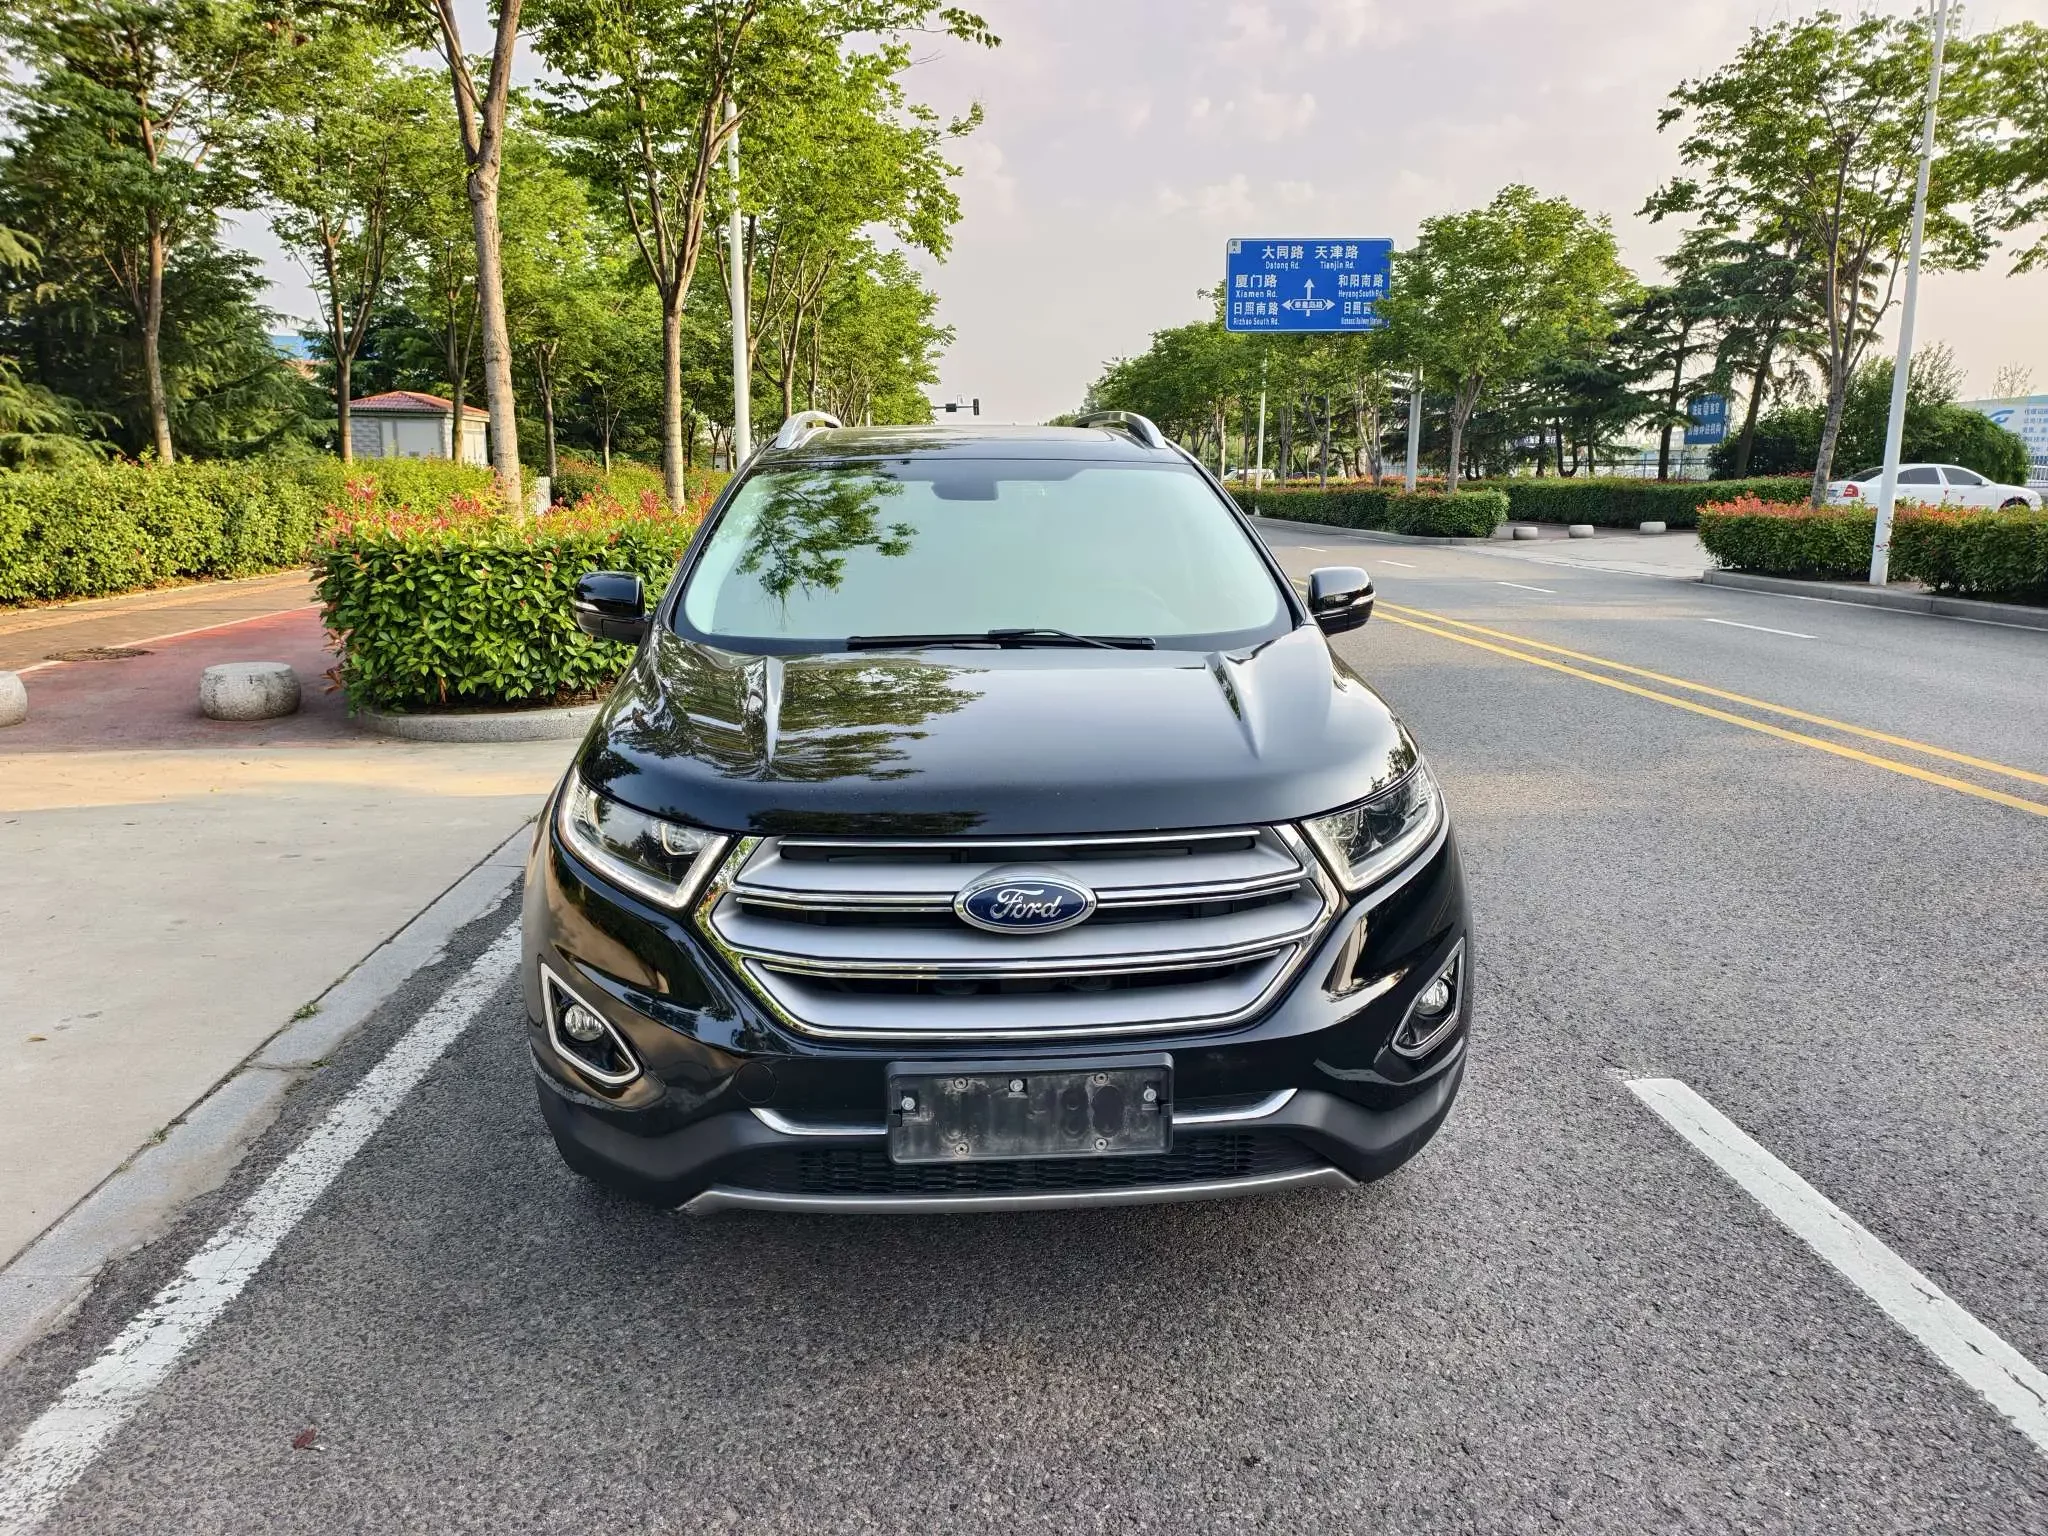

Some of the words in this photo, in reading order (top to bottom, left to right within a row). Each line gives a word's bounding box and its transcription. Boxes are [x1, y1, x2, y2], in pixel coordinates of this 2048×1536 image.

[1262, 245, 1304, 260] 大同路
[1314, 245, 1359, 260] 天津路
[1265, 261, 1289, 271] Datong
[1320, 261, 1343, 271] Tianjin
[1235, 274, 1277, 288] 厦门路
[1338, 274, 1384, 288] 和阳南路
[1235, 290, 1265, 298] Xiamen
[1234, 302, 1279, 316] 日照南路
[1253, 317, 1270, 325] South
[990, 888, 1063, 920] Ford
